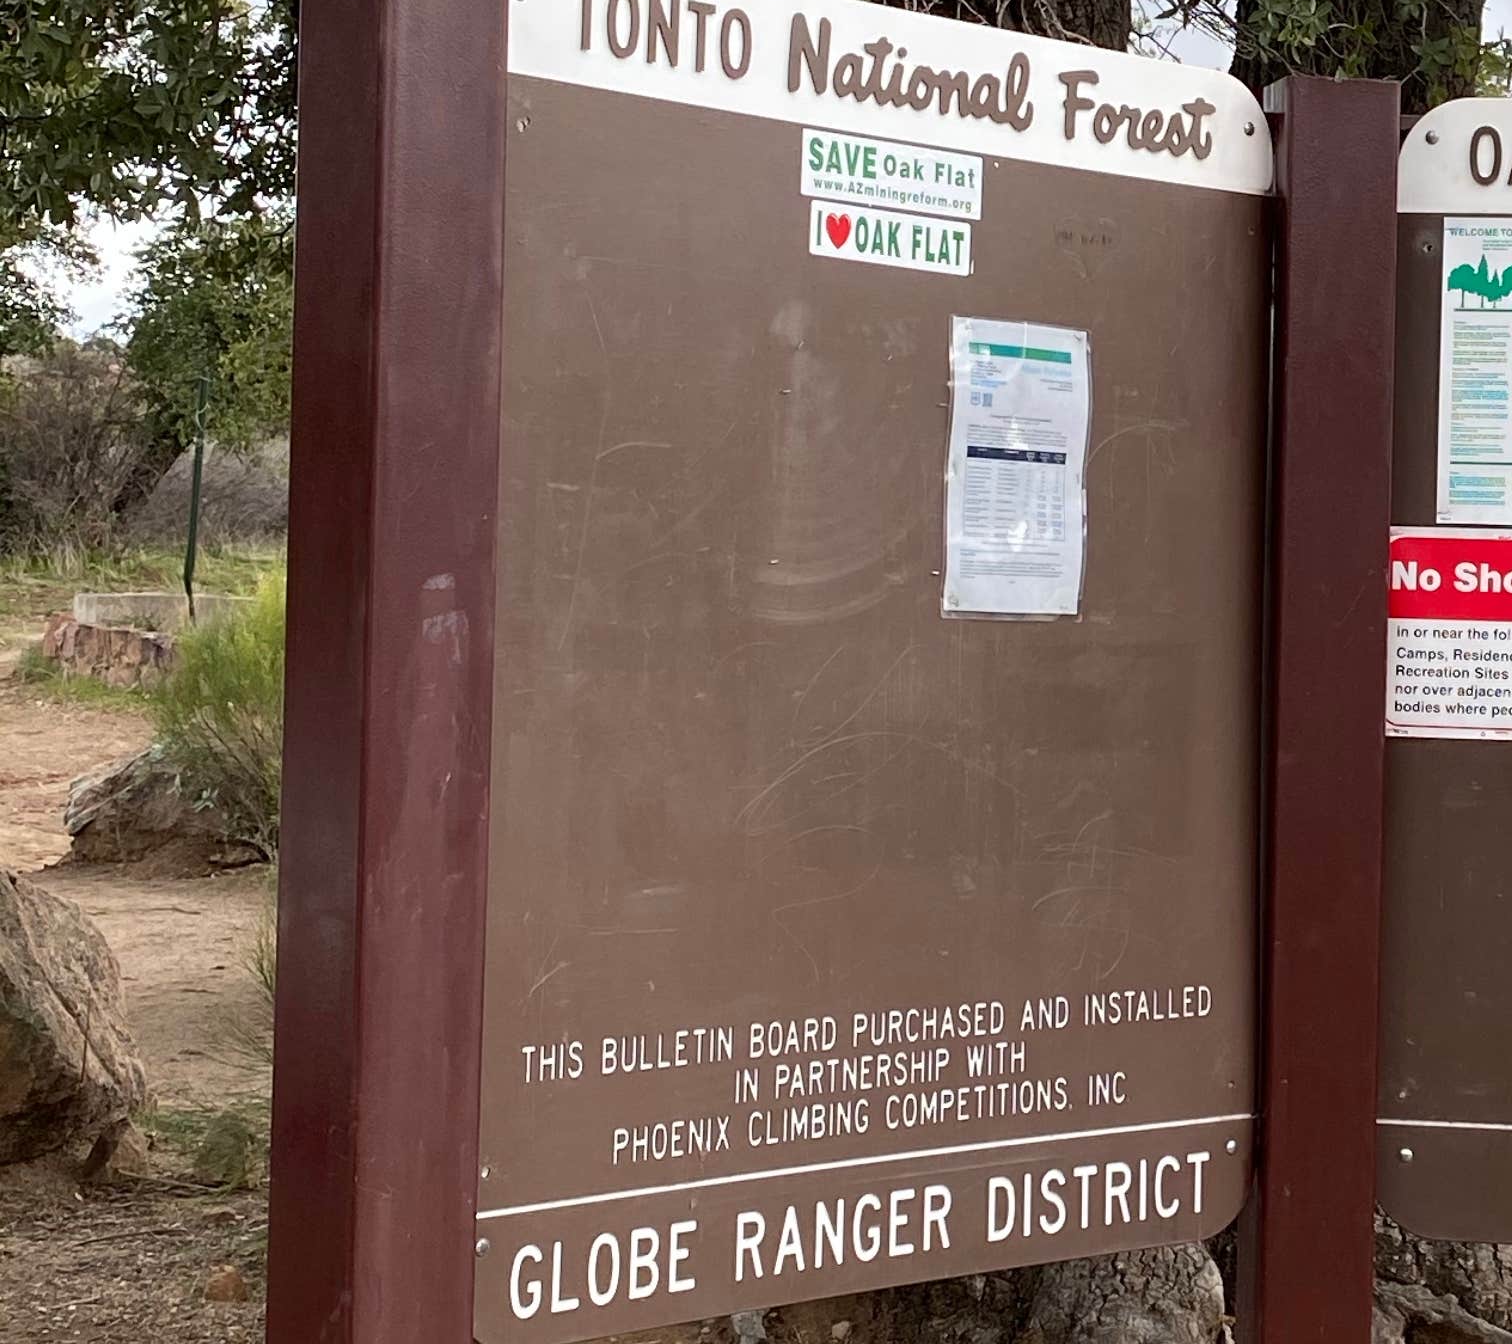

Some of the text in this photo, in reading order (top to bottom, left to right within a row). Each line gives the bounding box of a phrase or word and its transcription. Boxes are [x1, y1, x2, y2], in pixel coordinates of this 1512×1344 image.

[788, 13, 1034, 133] National
[1058, 70, 1216, 161] Forest
[809, 137, 975, 188] SAVE Oak Flat
[813, 178, 972, 213] www.AZminingreform.org
[816, 210, 964, 266] I OAK FLAT
[1450, 228, 1498, 237] WELCOME
[1500, 229, 1512, 237] TO
[1392, 560, 1441, 591] No
[1413, 628, 1428, 638] or
[1433, 629, 1463, 639] near
[1467, 628, 1489, 640] the
[1396, 647, 1448, 661] Camps,
[1395, 665, 1470, 679] Recreation
[1474, 667, 1509, 680] Sites
[1395, 684, 1418, 695] nor
[1422, 686, 1453, 696] over
[1394, 701, 1441, 713] bodies
[1445, 702, 1487, 715] where
[522, 986, 1212, 1084] THIS BULLETIN BOARD PURCHASED AND INSTALLED
[734, 1042, 1025, 1104] IN PARTNERSHIP WITH
[613, 1116, 730, 1165] PHOENIX
[748, 1100, 868, 1148] CLIMBING
[1088, 1071, 1126, 1106] INC
[509, 1152, 1211, 1320] GLOBE RANGER DISTRICT
